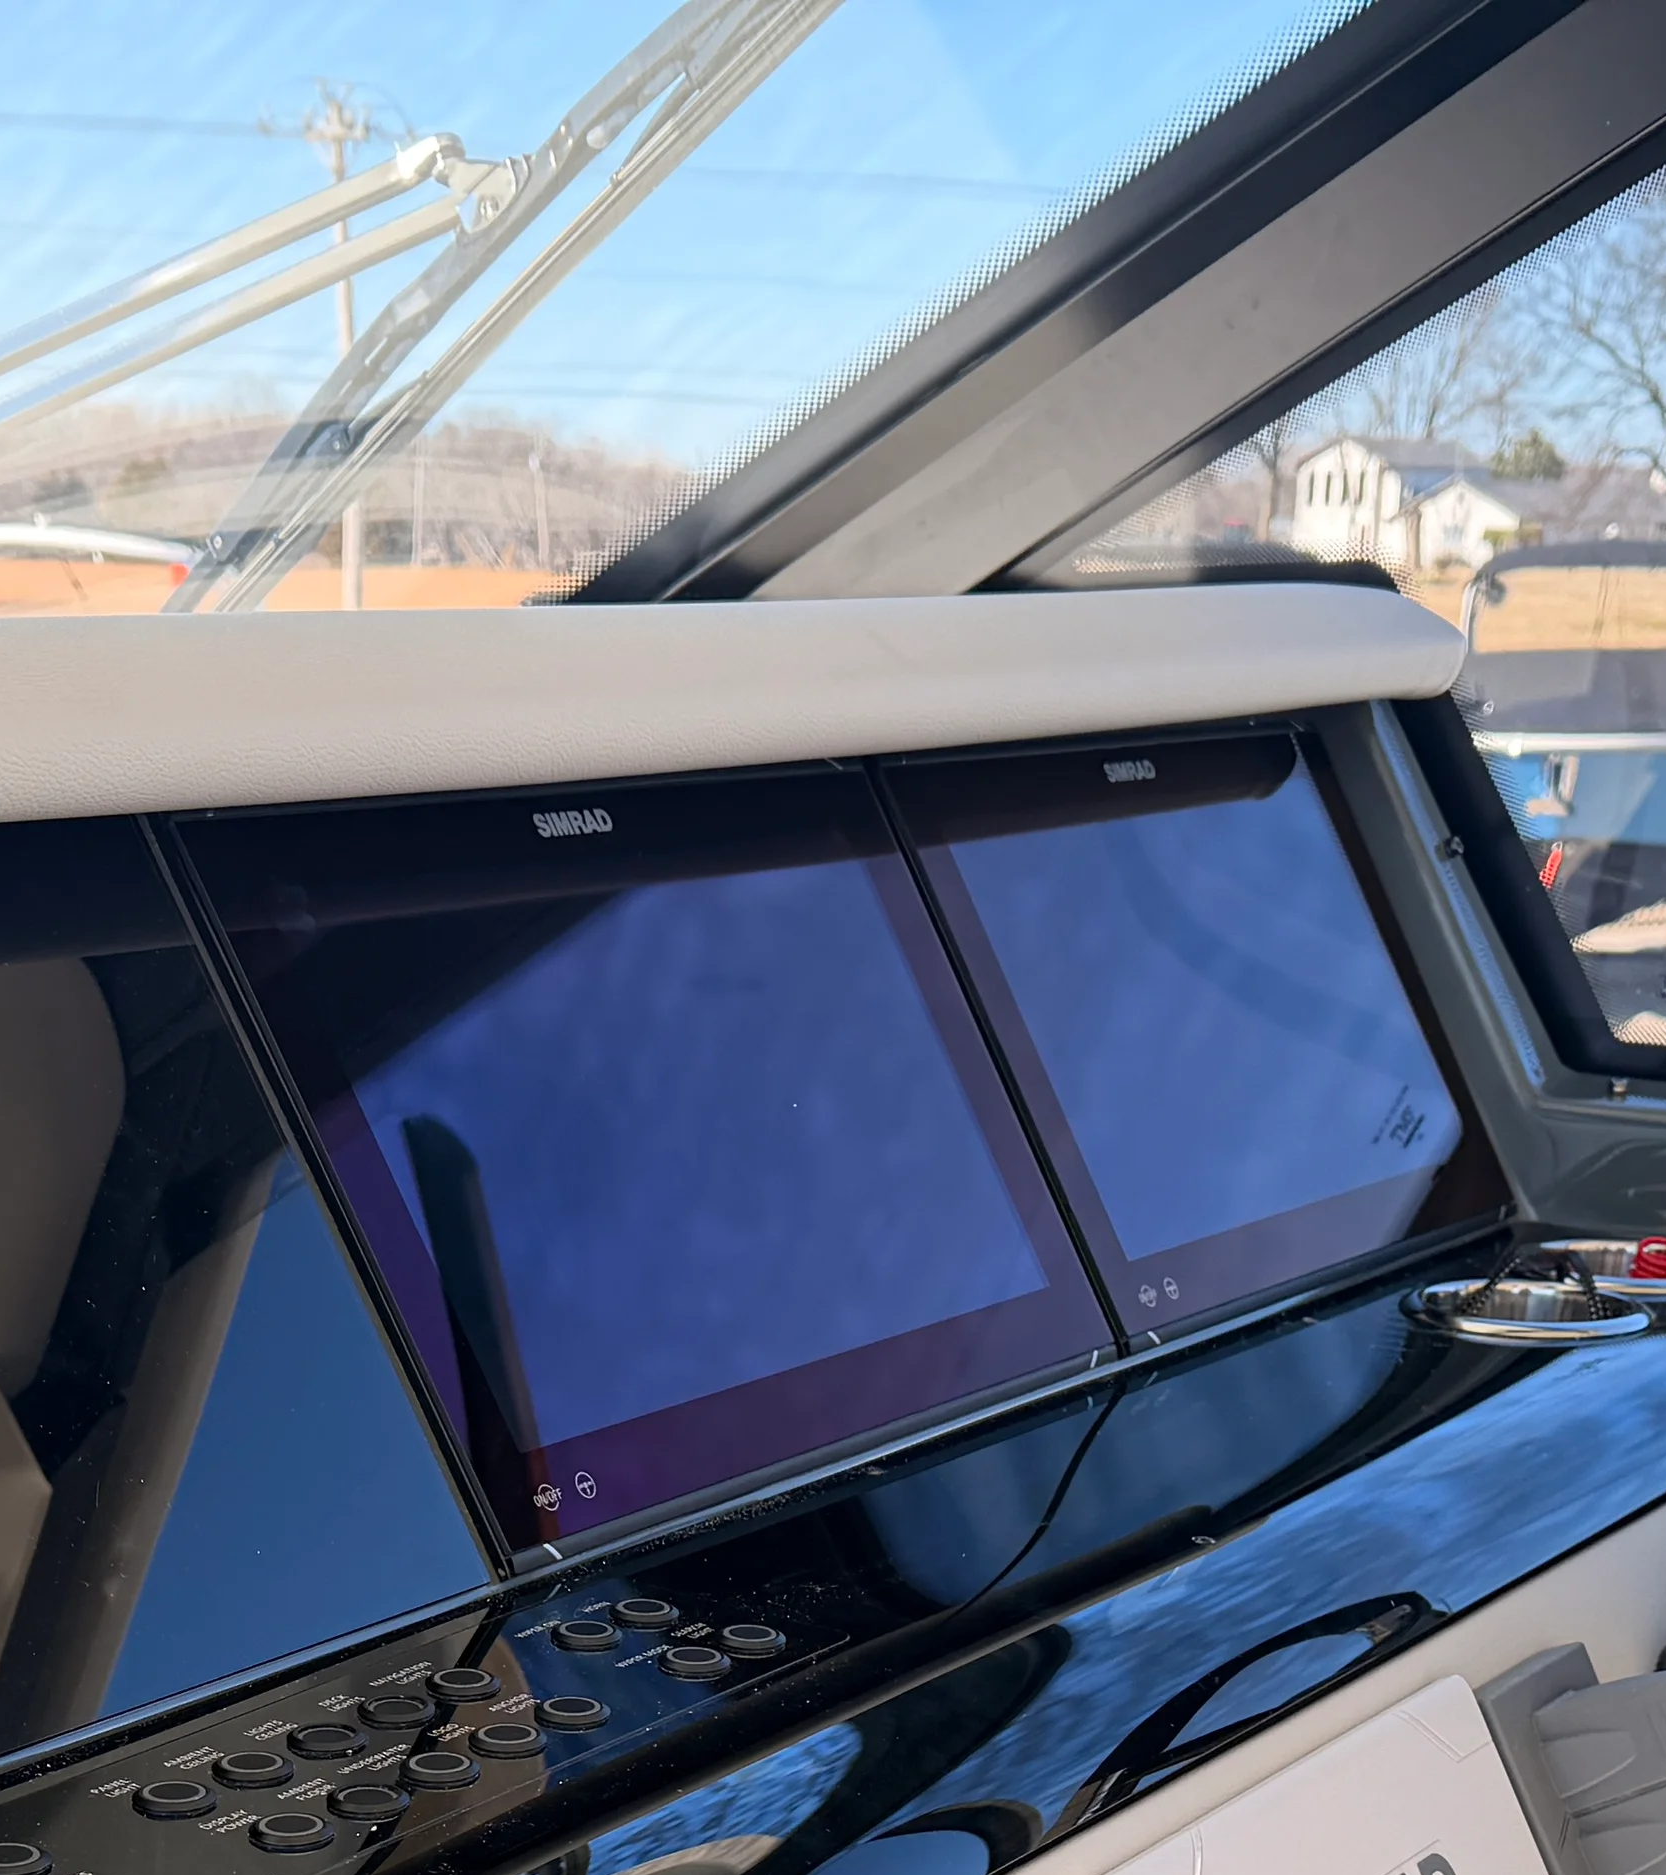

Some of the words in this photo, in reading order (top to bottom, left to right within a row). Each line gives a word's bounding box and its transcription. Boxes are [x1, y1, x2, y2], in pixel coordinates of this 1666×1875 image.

[1103, 759, 1157, 784] SIMRAD
[533, 808, 613, 840] SIMRAD
[533, 1487, 563, 1509] ON/OFF
